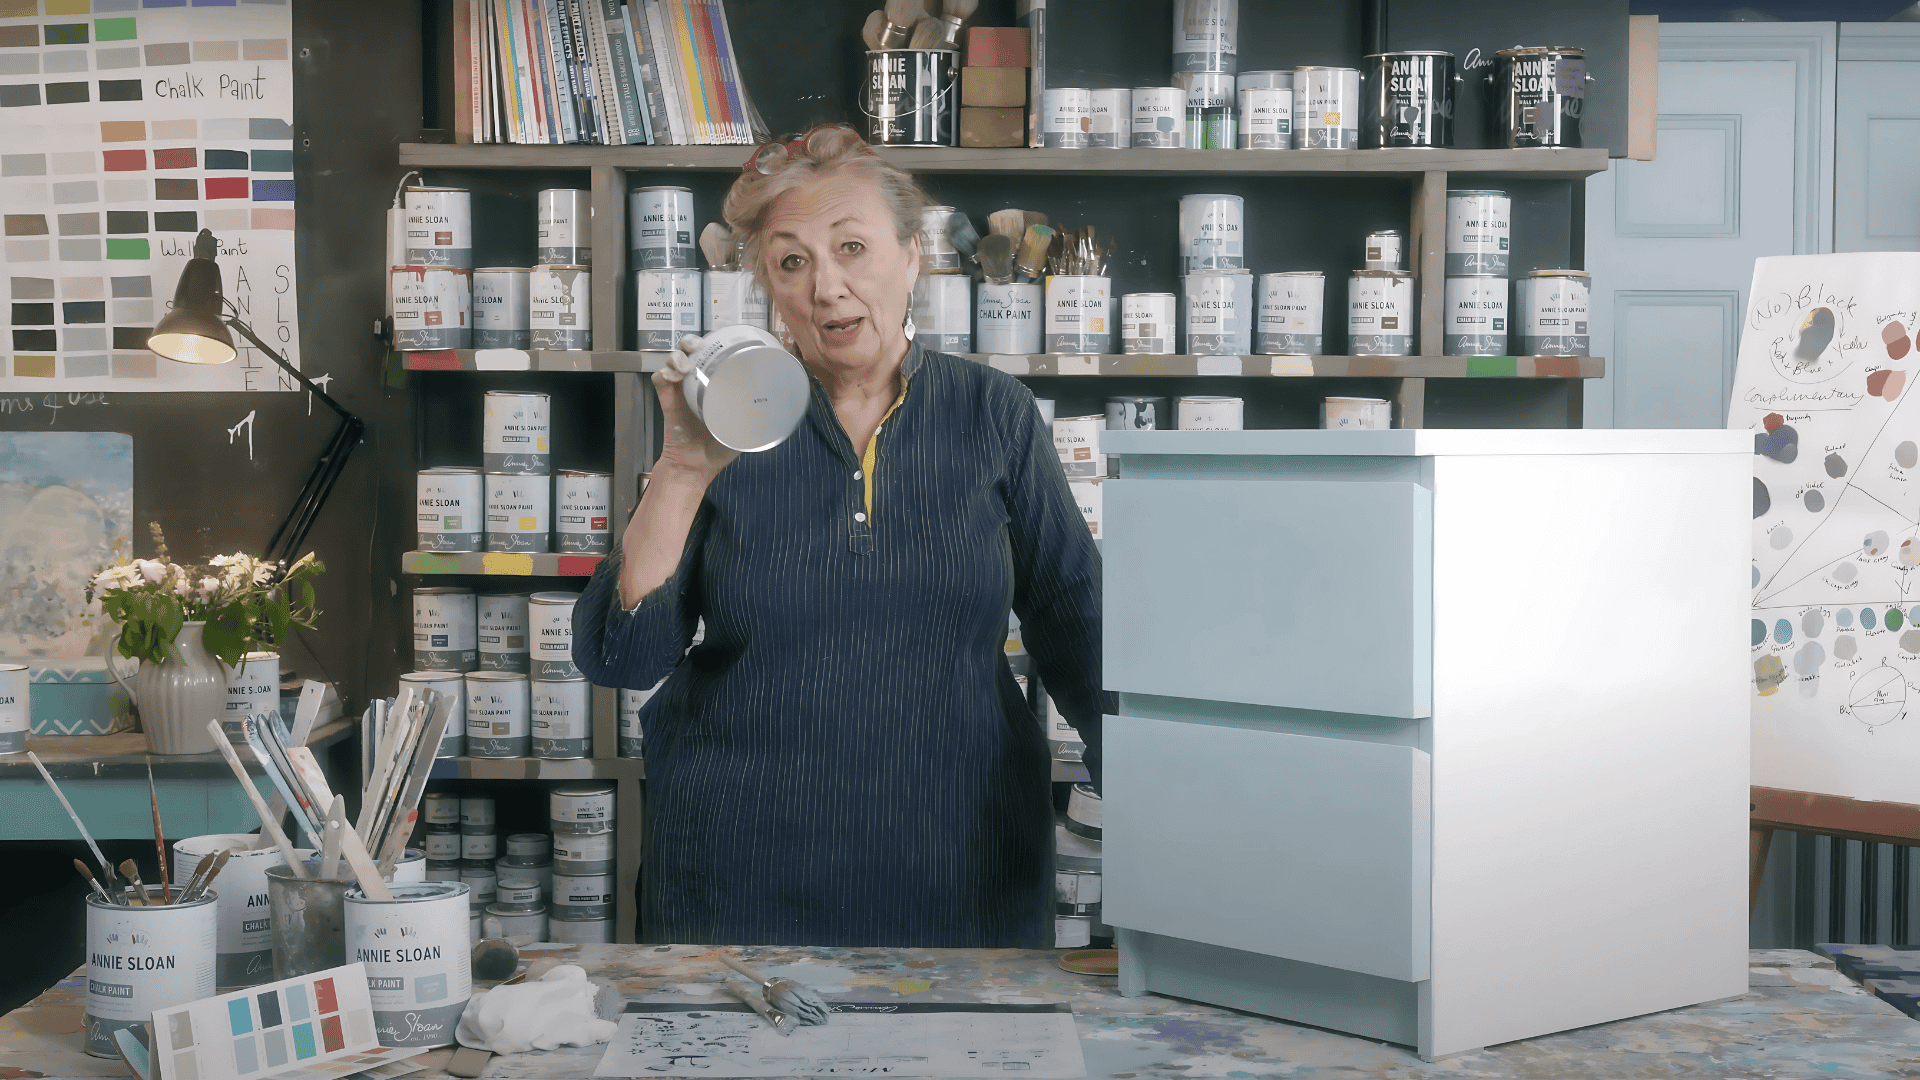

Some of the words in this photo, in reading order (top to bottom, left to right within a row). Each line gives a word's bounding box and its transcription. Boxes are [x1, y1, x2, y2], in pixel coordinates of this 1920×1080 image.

[557, 0, 568, 25] PAINT
[607, 0, 615, 15] LOAN
[571, 2, 582, 29] PAINT
[562, 26, 573, 58] EFFECTS
[574, 29, 587, 61] EFFECTS
[614, 38, 622, 56] ROOM
[547, 6, 563, 64] NURSERY
[555, 70, 567, 105] STYLE
[617, 56, 627, 77] RECIPES
[872, 58, 906, 73] ANNIE
[1515, 61, 1556, 76] ANNIE
[155, 72, 205, 100] Chalk
[219, 66, 266, 100] Paint
[872, 75, 906, 89] SLOAN
[1515, 78, 1556, 92] SLOAN
[622, 83, 631, 99] STYLE
[1208, 98, 1225, 106] SLOA
[626, 105, 636, 126] COLOUR
[414, 295, 439, 303] SLOAN
[481, 296, 503, 304] SLOAN
[1057, 300, 1078, 308] ANNIE
[1795, 283, 1857, 318] Black
[980, 310, 1003, 319] CHALK
[1006, 310, 1032, 319] PAINT
[1793, 362, 1821, 376] Blue
[1744, 387, 1864, 406] Complimentary
[436, 499, 460, 507] SLOAN
[1881, 657, 1887, 667] R
[228, 687, 246, 695] NNIE
[0, 696, 15, 705] OAN
[247, 895, 270, 908] ANN
[92, 953, 122, 969] ANNIE
[127, 955, 175, 970] SLOAN
[357, 949, 391, 962] ANNIE
[396, 946, 440, 962] SLOAN
[108, 987, 130, 996] PAINT
[378, 980, 401, 988] PAINT
[394, 1013, 443, 1041] Sloan
